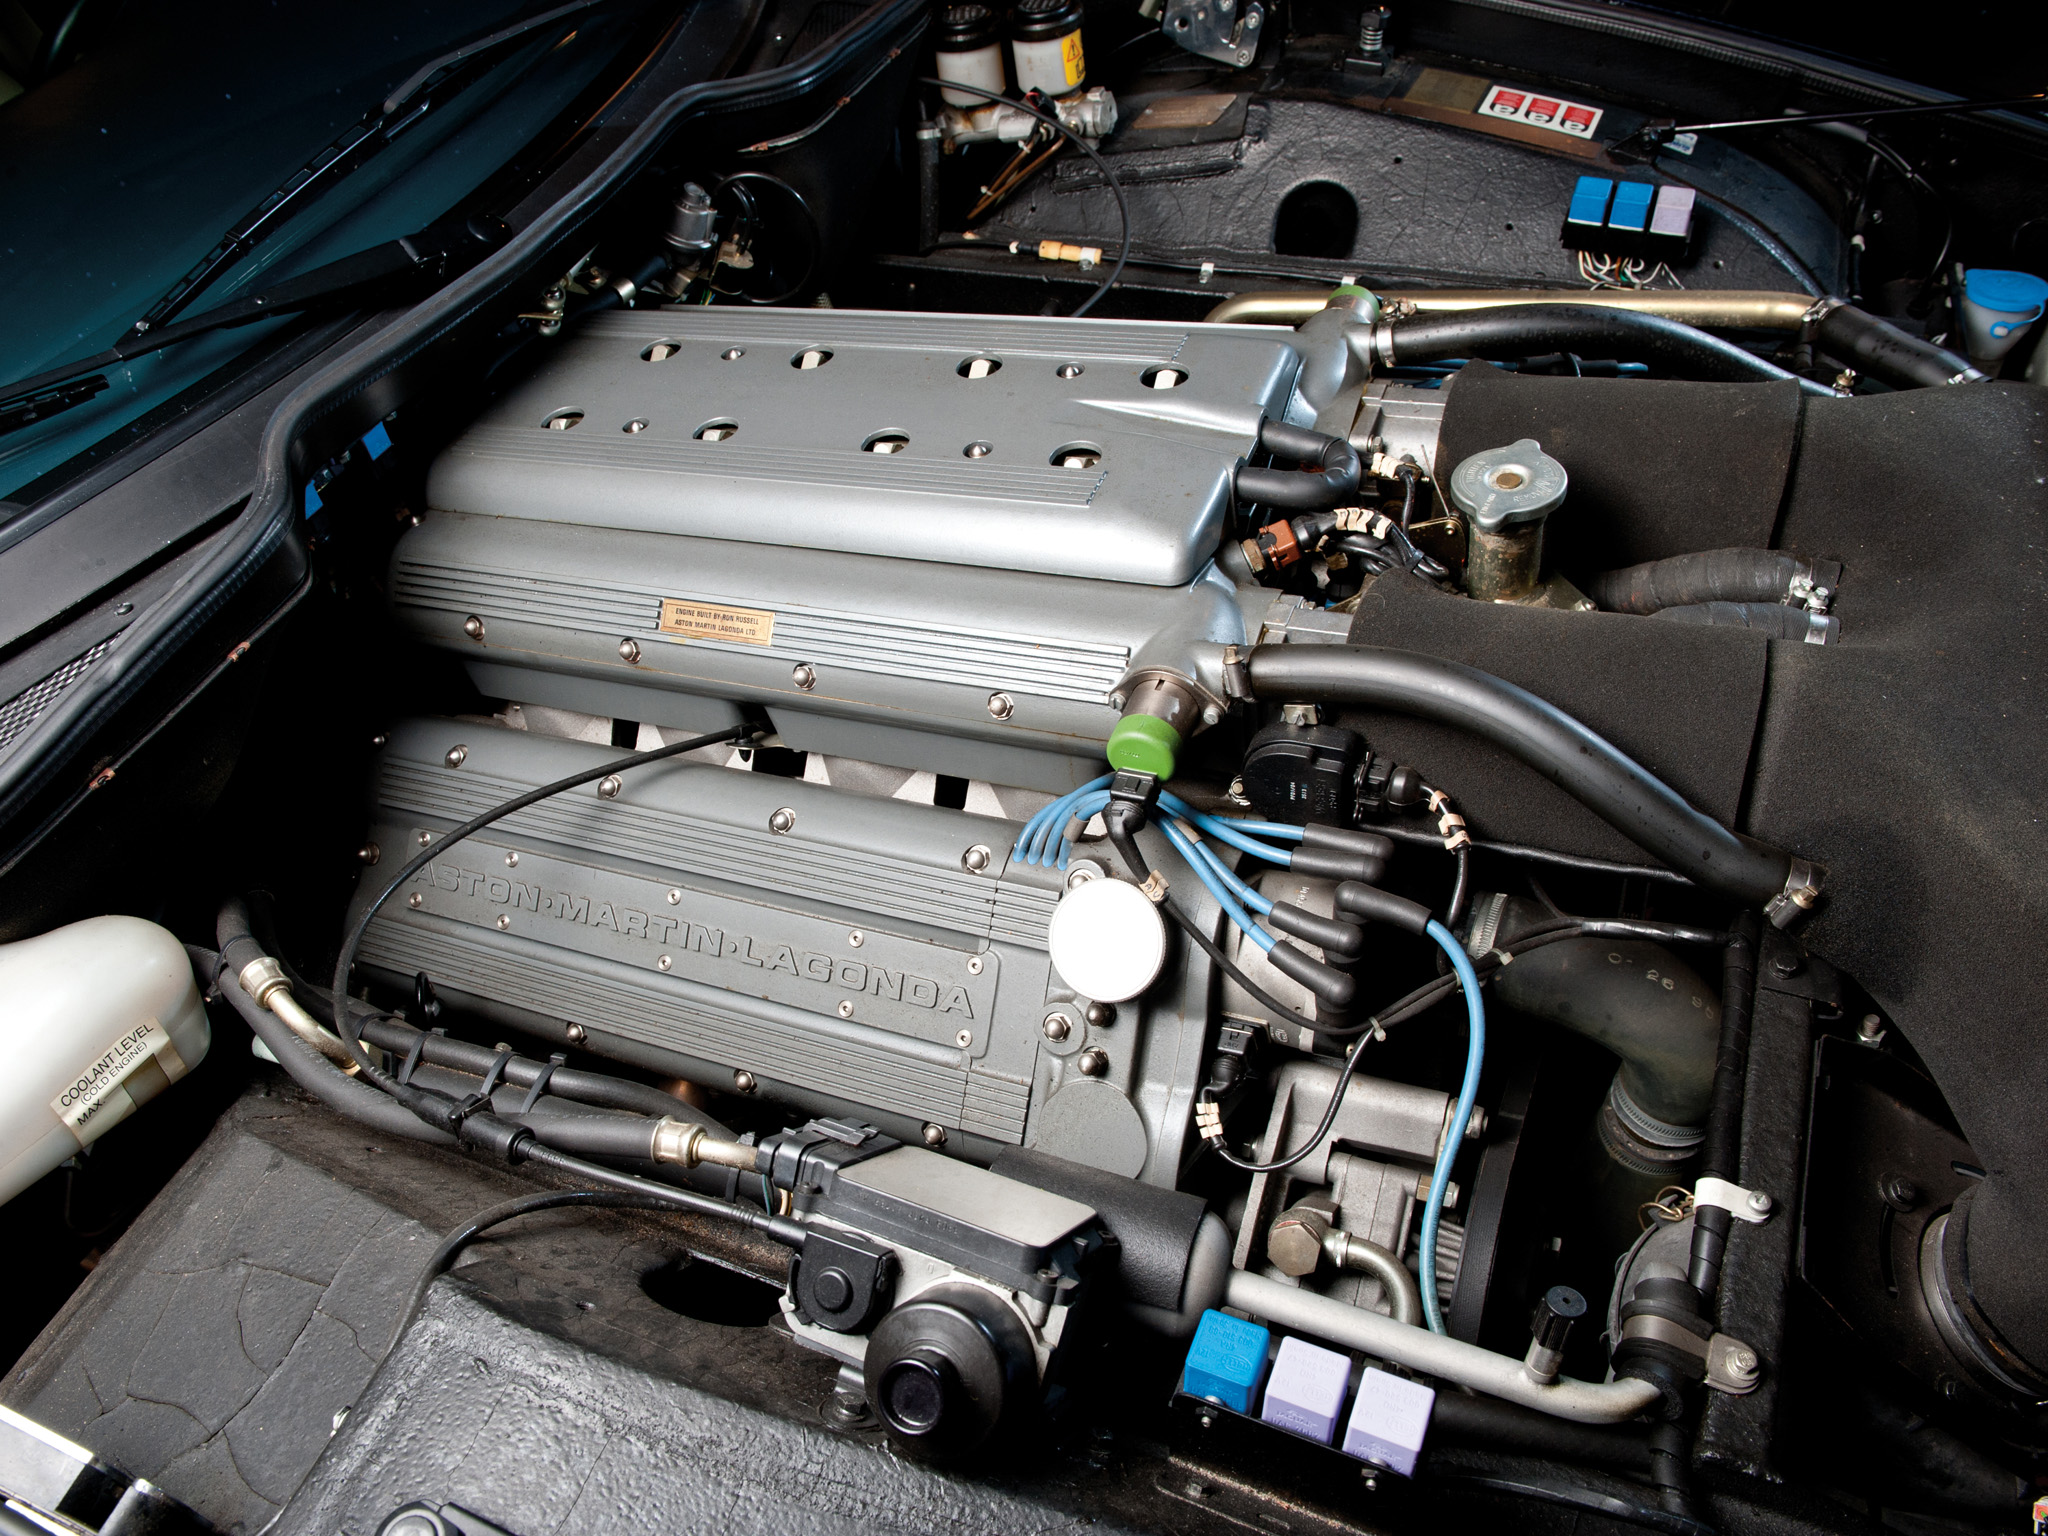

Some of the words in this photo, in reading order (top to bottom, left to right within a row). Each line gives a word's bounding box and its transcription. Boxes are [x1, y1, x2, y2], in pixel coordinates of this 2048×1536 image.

[674, 618, 693, 627] ASTON
[694, 621, 716, 631] MARTIN
[718, 624, 744, 634] LAGONDA
[745, 628, 756, 636] LTD
[675, 607, 695, 617] ENGINE
[696, 609, 712, 619] BUILT
[713, 612, 720, 620] BY
[721, 613, 734, 622] RON
[735, 615, 759, 625] RUSSELL
[410, 862, 542, 913] ASTON
[554, 892, 725, 958] MARTIN
[740, 936, 975, 1020] LAGONDA
[60, 1052, 115, 1107] COOLANT
[114, 1024, 154, 1057] LEVEL
[80, 1076, 110, 1106] (COLD
[109, 1041, 148, 1078] ENGINE)
[76, 1098, 106, 1126] MAX.
